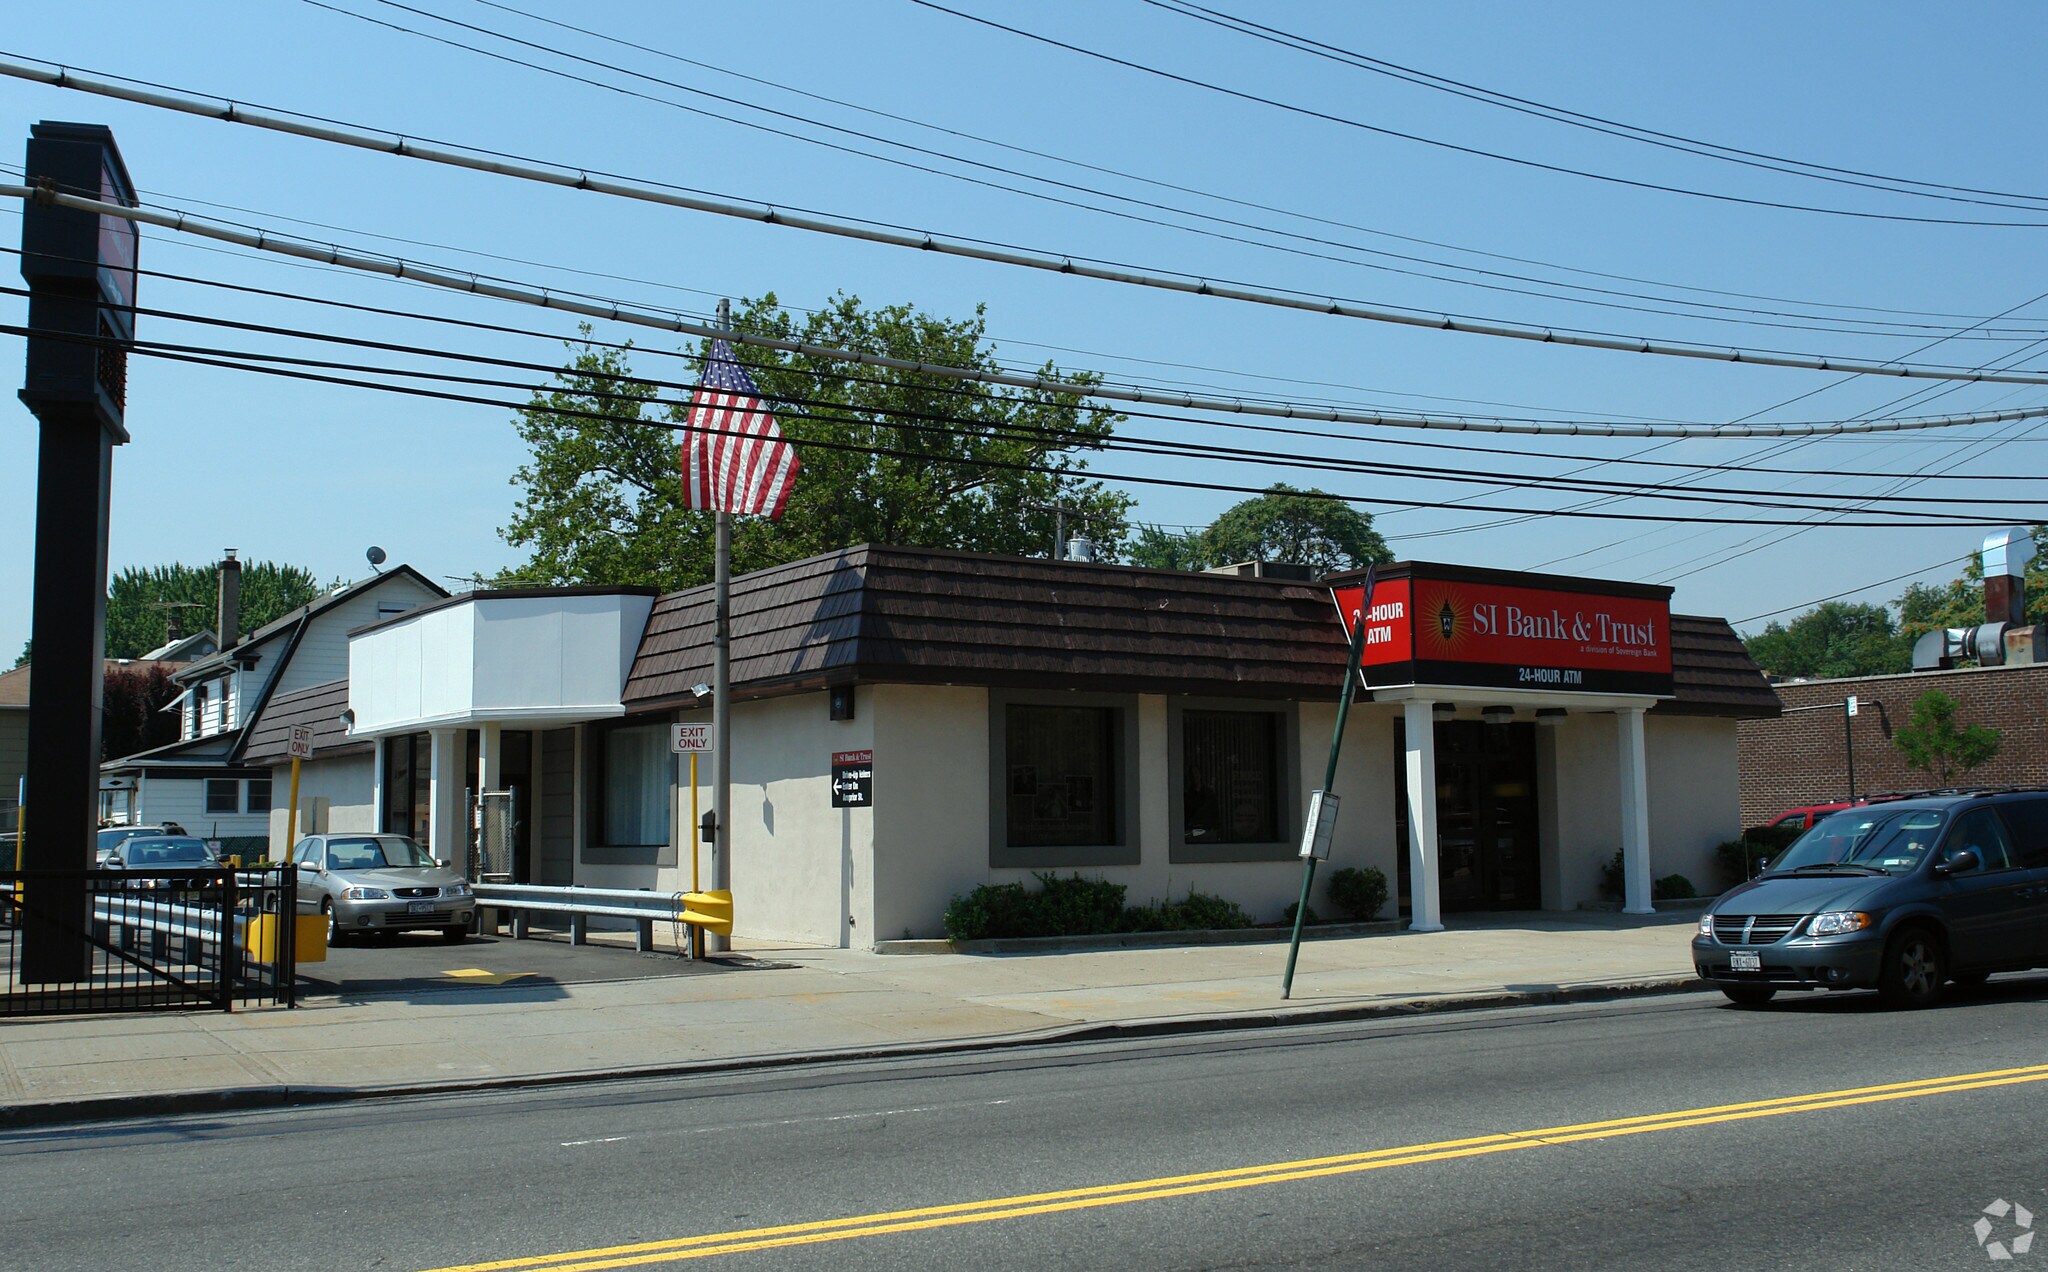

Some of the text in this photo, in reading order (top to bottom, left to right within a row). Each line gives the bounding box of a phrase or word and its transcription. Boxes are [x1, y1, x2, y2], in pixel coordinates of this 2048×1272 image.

[1353, 602, 1404, 625] 2-HOUR
[1473, 603, 1657, 646] SI Bank & Trust
[1367, 626, 1392, 645] ATM
[1586, 645, 1607, 654] division
[1608, 646, 1615, 654] of
[1615, 646, 1642, 657] Sovereign
[1643, 648, 1657, 657] Bank
[1519, 667, 1582, 684] 24-HOUR ATM
[294, 729, 310, 741] EXIT
[680, 727, 705, 737] EXIT
[292, 741, 310, 754] ONLY
[678, 738, 707, 748] ONLY
